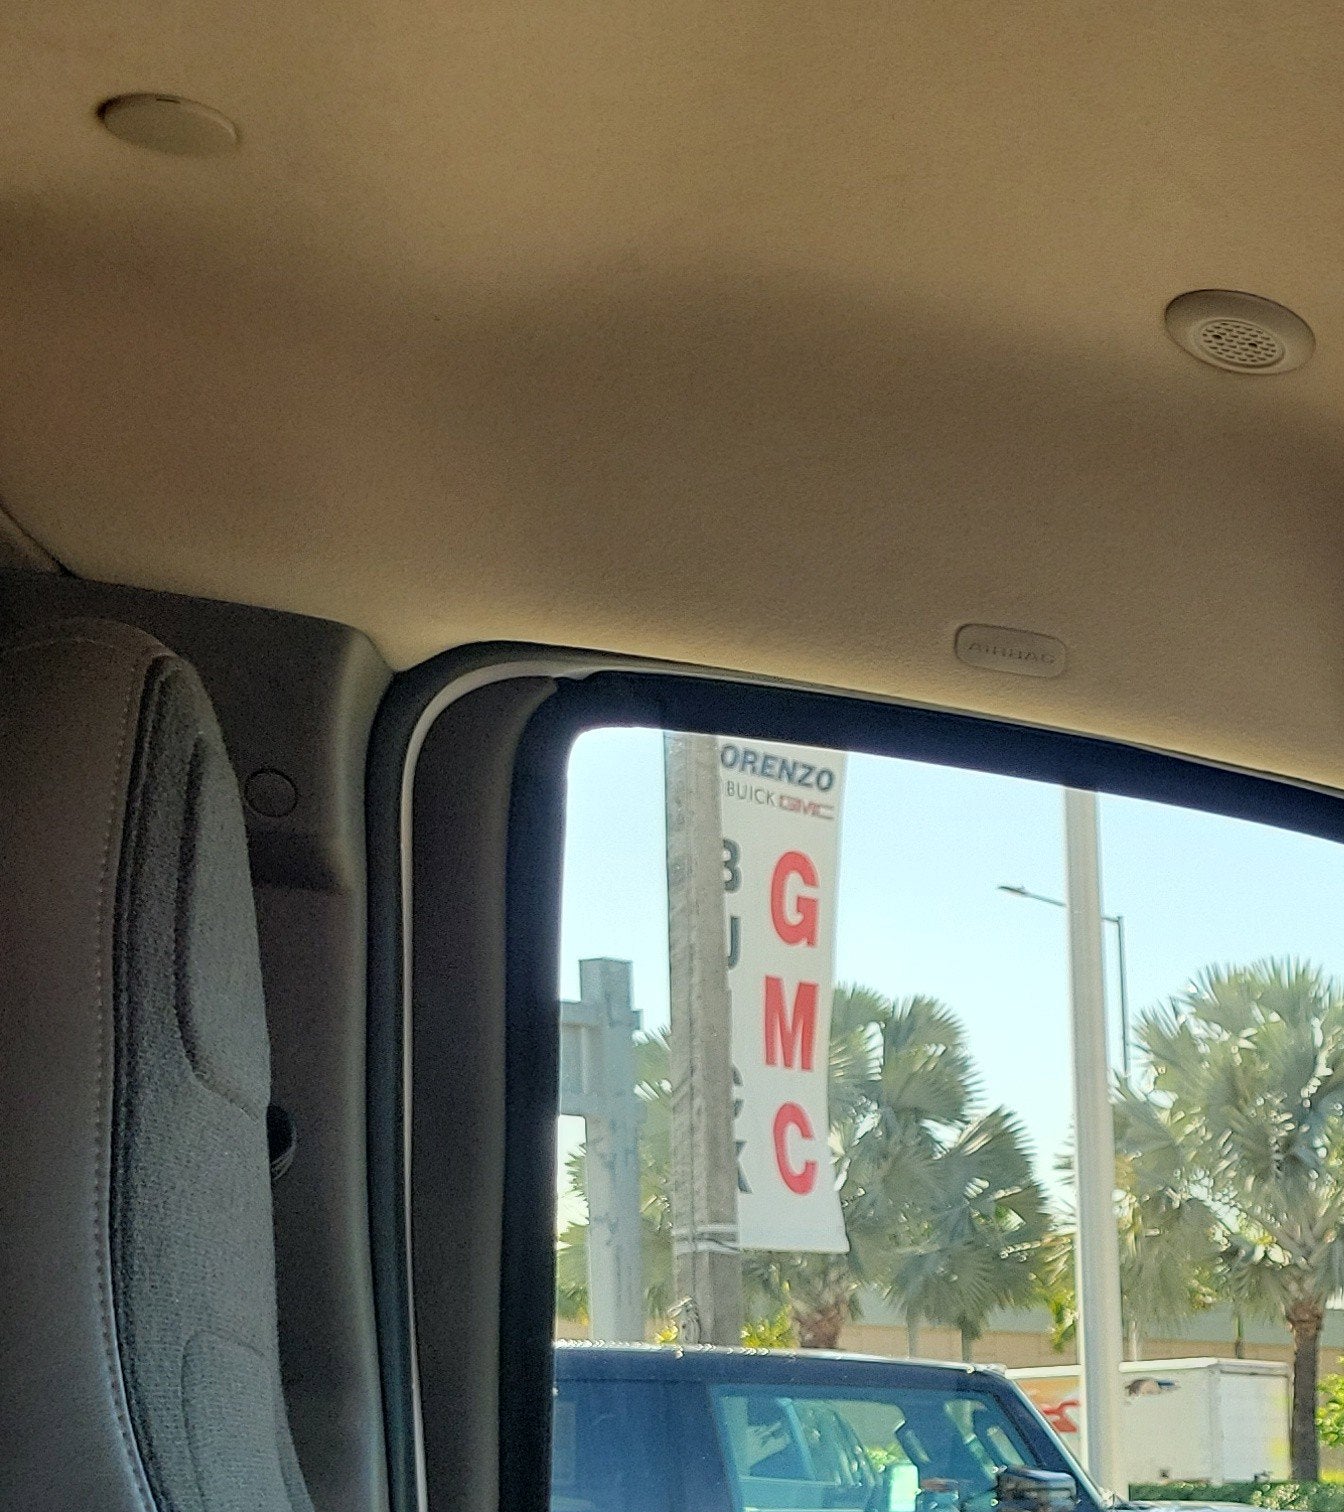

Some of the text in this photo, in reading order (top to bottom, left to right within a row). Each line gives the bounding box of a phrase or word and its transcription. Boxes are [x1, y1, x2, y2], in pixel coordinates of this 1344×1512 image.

[720, 743, 835, 793] ORENZO
[726, 781, 835, 820] BUICK GMC
[764, 850, 820, 1196] GMC
